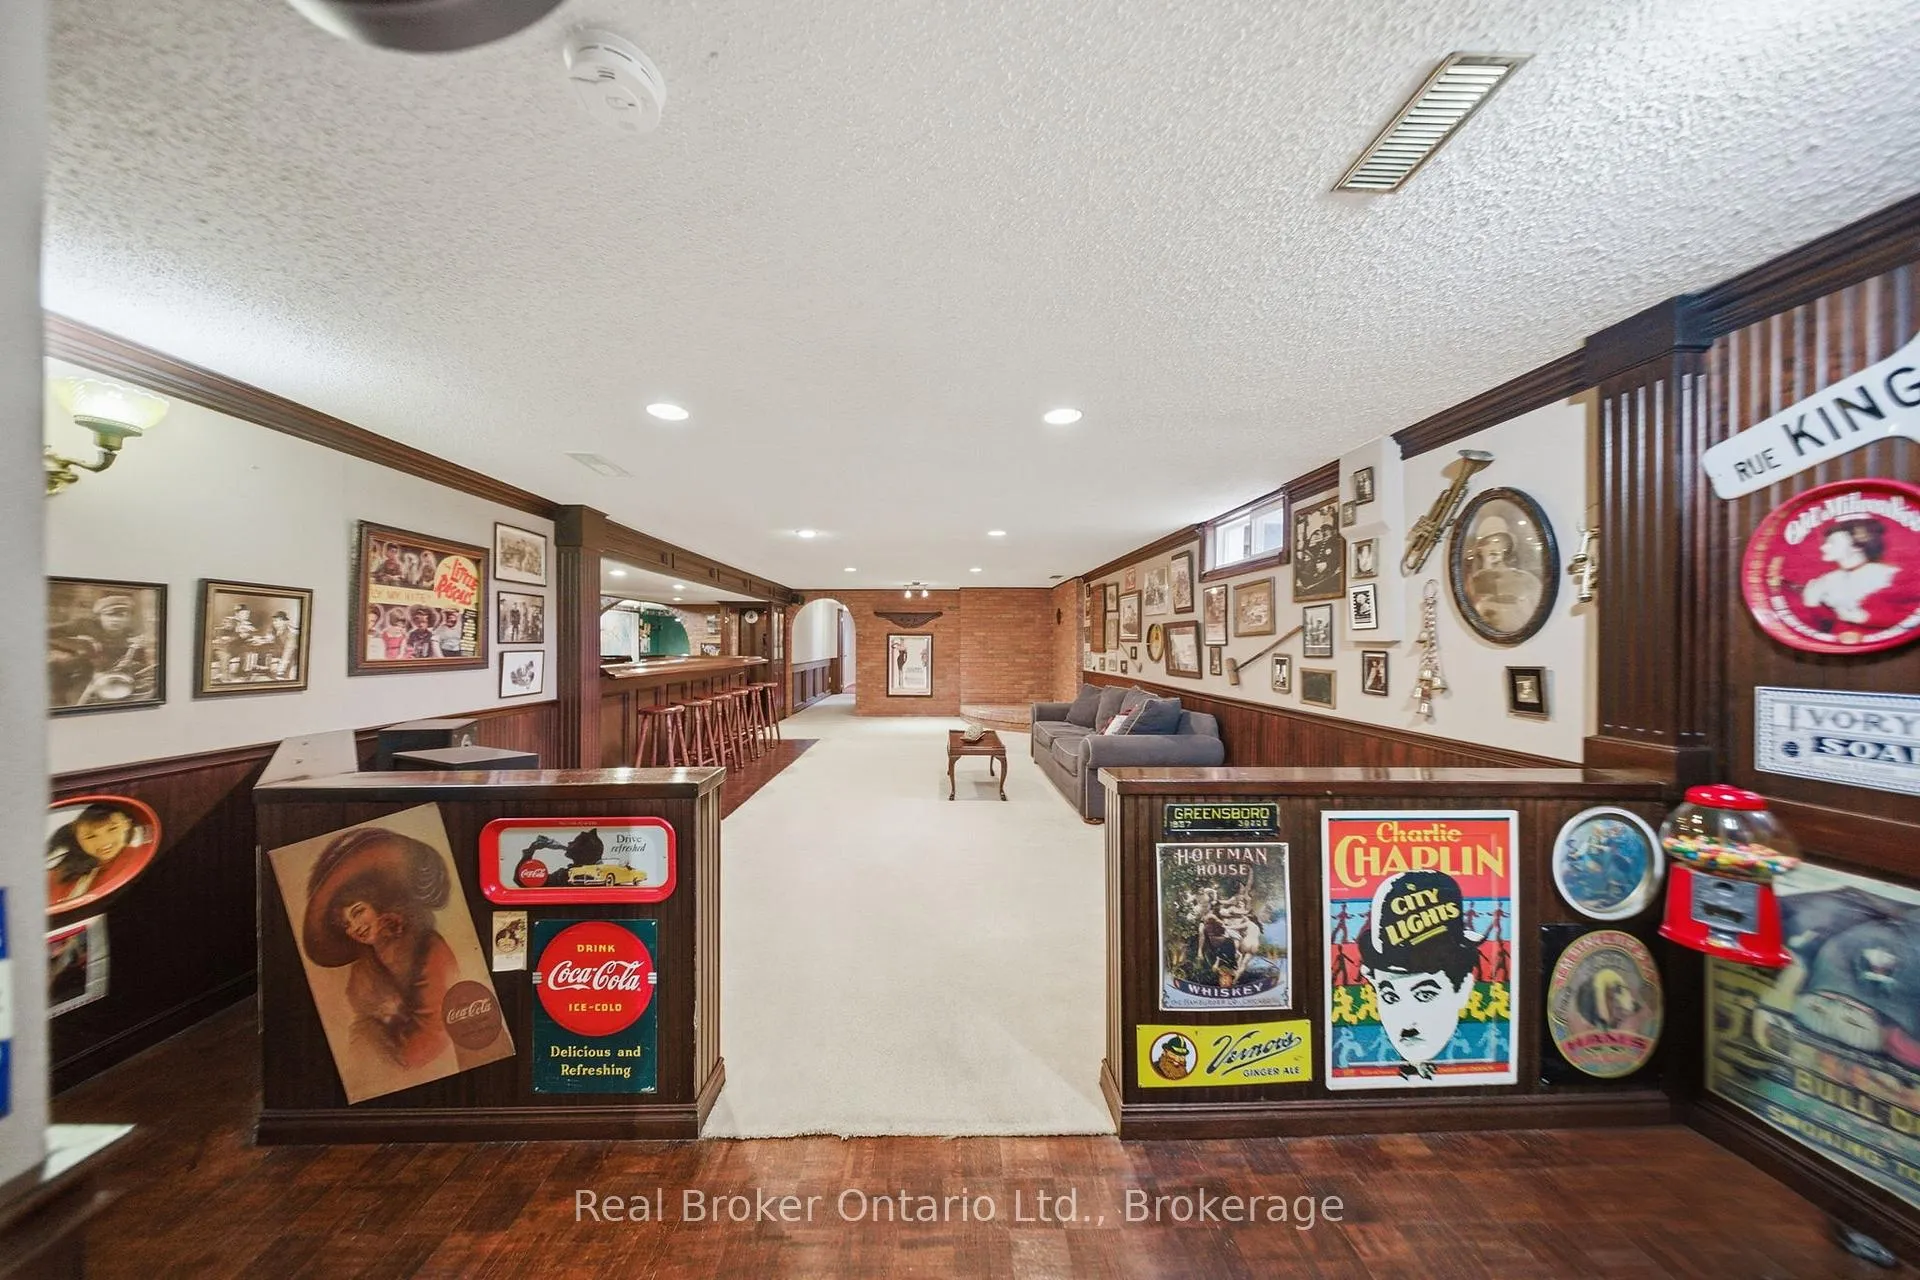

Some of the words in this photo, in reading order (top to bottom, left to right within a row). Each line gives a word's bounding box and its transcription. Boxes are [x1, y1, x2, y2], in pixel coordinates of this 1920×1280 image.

[1734, 448, 1781, 482] RUE
[1782, 366, 1920, 457] KING
[1788, 703, 1915, 736] IVORY
[1174, 807, 1270, 820] GREENSBORO
[616, 834, 643, 843] Drive
[1376, 822, 1463, 843] Charlie
[611, 843, 647, 855] refreshed
[1175, 847, 1269, 866] HOFFMAN
[1334, 835, 1505, 888] CHAPLIN
[1196, 864, 1248, 876] HOUSE
[1390, 888, 1439, 915] CITY
[1385, 902, 1460, 946] LIGHTS
[577, 944, 616, 953] DRINK
[548, 960, 645, 991] Coca-Cola
[1188, 982, 1264, 999] WHISKEY
[568, 1003, 622, 1012] ICE-COLD
[550, 1045, 611, 1058] Delicious
[617, 1045, 641, 1058] and
[560, 1063, 632, 1079] Refreshing
[1243, 1067, 1280, 1078] GINGER
[1283, 1066, 1301, 1076] ALE
